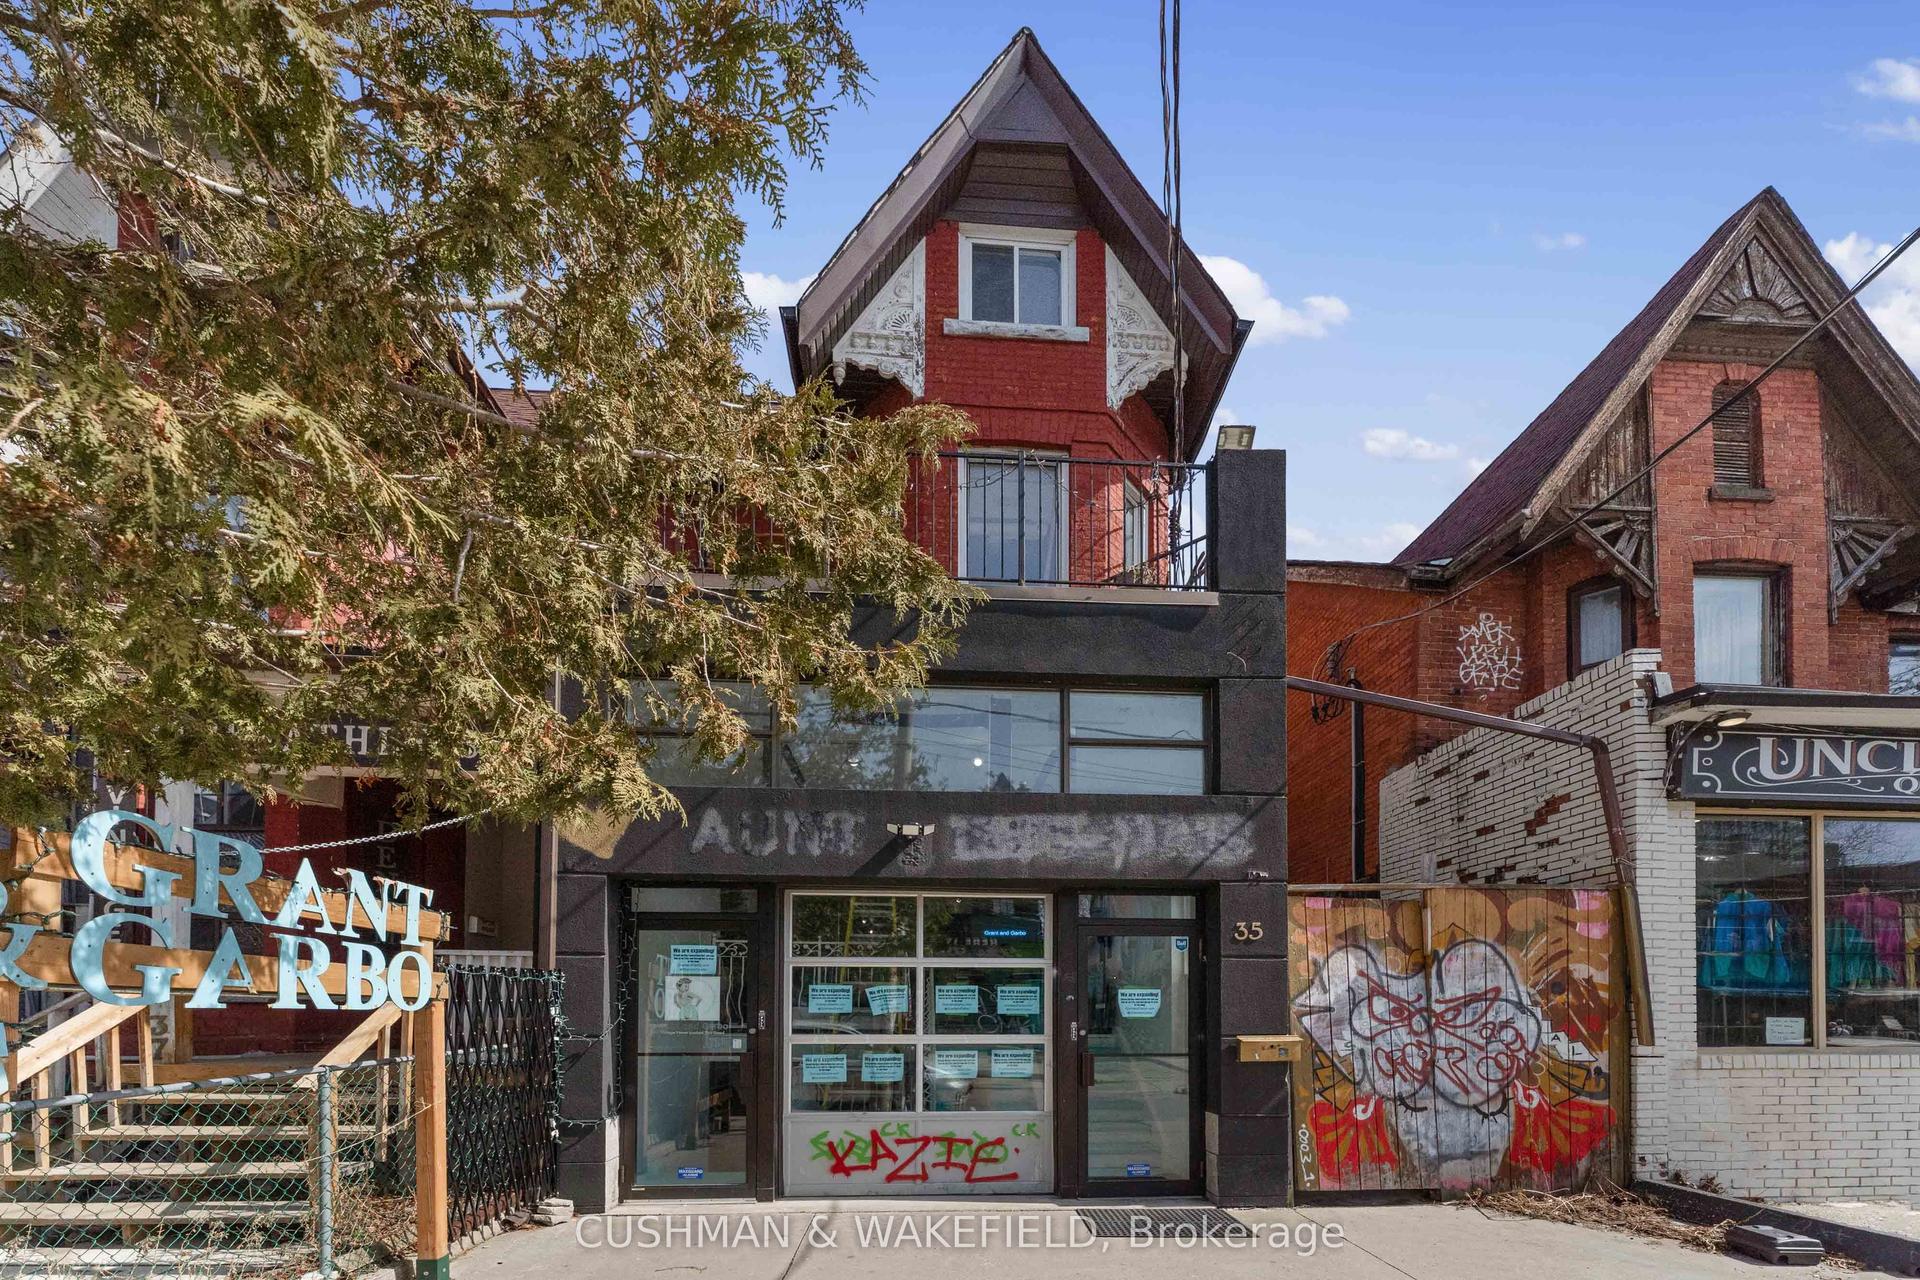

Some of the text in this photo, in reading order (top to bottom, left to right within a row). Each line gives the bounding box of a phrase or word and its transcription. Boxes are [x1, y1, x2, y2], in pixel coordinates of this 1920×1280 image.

[70, 809, 433, 948] GRANT
[70, 912, 433, 1012] GARBO
[1234, 921, 1264, 941] 35
